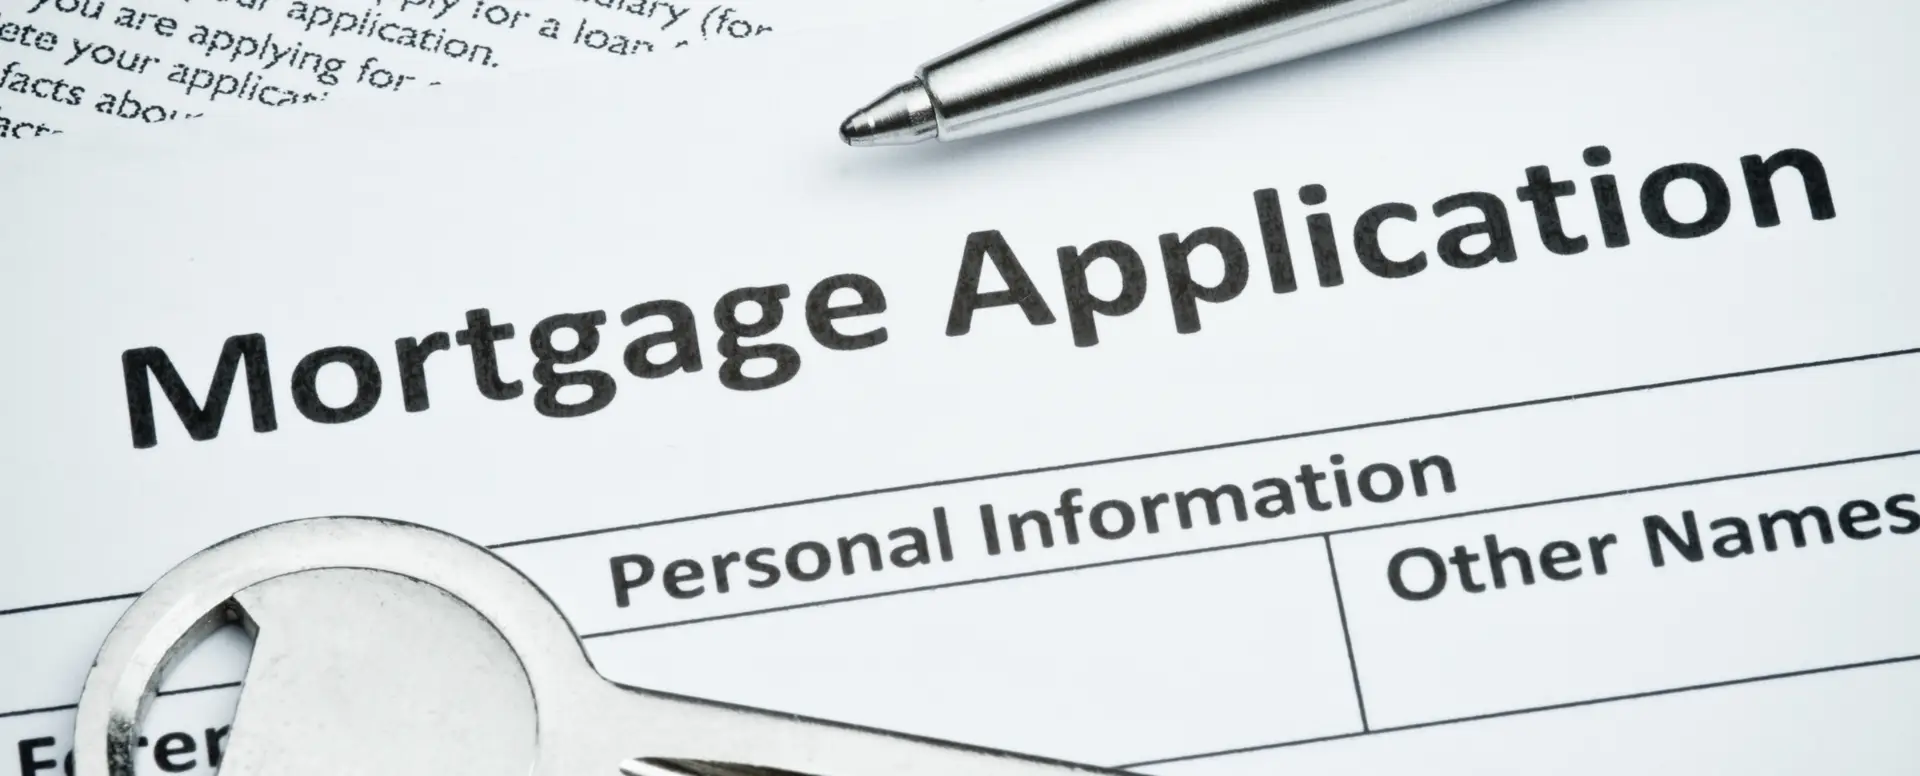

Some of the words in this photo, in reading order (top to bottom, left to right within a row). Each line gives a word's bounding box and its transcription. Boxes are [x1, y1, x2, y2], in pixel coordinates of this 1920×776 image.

[63, 38, 161, 74] your
[114, 7, 178, 37] are
[188, 25, 346, 86] applying
[287, 1, 499, 68] application.
[538, 18, 561, 39] a
[0, 61, 86, 106] facts
[121, 272, 889, 450] Mortgage
[945, 145, 1838, 348] Application
[609, 506, 955, 608] Personal
[979, 453, 1457, 555] Information
[1387, 533, 1617, 601] Other
[1642, 493, 1920, 568] Names
